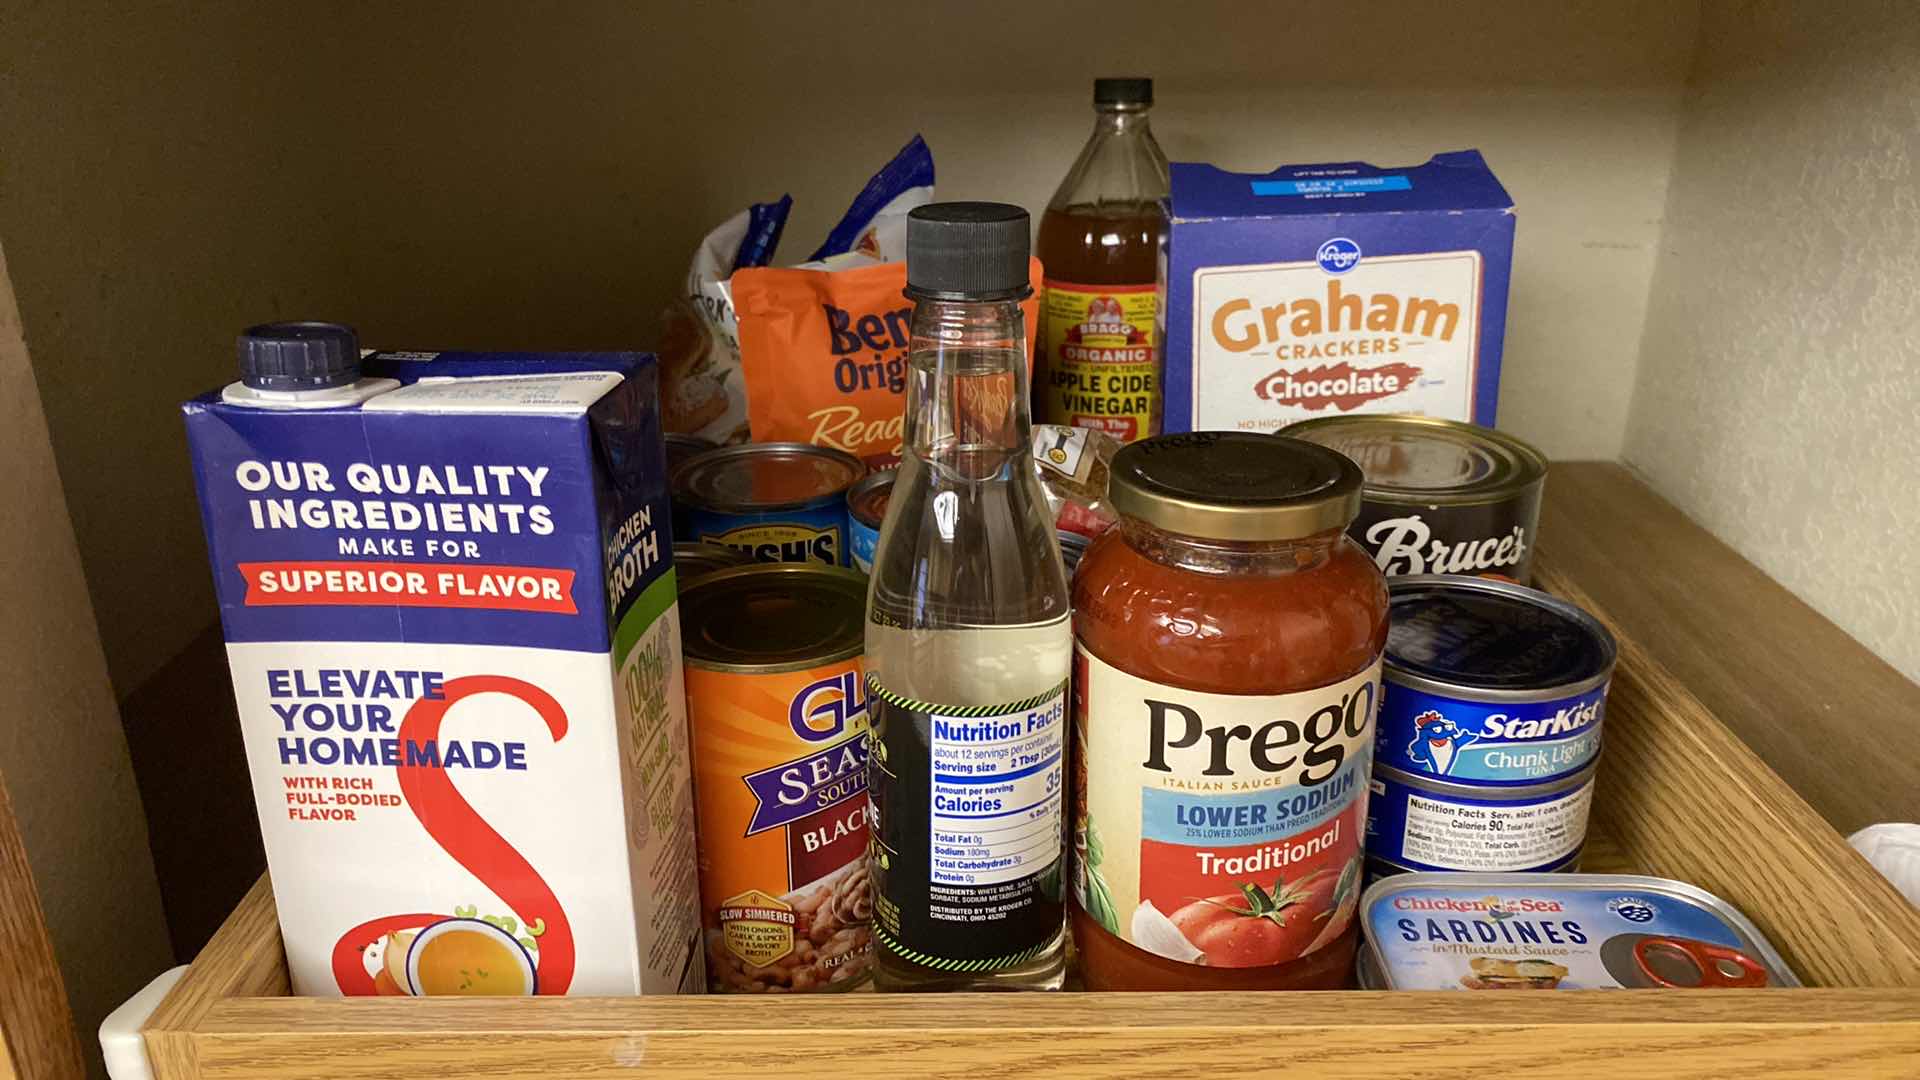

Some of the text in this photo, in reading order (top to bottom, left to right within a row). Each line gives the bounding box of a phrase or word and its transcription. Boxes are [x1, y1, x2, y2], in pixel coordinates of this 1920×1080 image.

[1320, 245, 1358, 268] Kroger
[1211, 279, 1460, 353] Graham
[1080, 323, 1133, 335] BRAGG
[1065, 348, 1147, 362] ORGANIC
[1276, 337, 1400, 361] CRACKERS
[1265, 371, 1399, 401] Chocolate
[1062, 394, 1148, 415] VINEGAR
[235, 460, 551, 498] OUR QUALITY
[249, 499, 555, 535] INGREDIENTS
[338, 537, 481, 558] MAKE FOR
[608, 504, 652, 571] CHICKEN
[1366, 514, 1527, 577] Bruce's
[706, 534, 836, 566] USH'S
[609, 530, 659, 616] BROTH
[258, 568, 563, 601] SUPERIOR FLAVOR
[266, 669, 446, 702] ELEVATE
[271, 704, 396, 734] YOUR
[934, 703, 1062, 742] Nutrition Facts
[1479, 700, 1601, 739] StarKist
[1142, 681, 1374, 787] Prego
[277, 736, 528, 771] HOMEMADE
[934, 748, 959, 759] about
[961, 748, 972, 759] 12
[974, 748, 1009, 761] servings
[1010, 758, 1017, 768] 2
[1019, 752, 1040, 766] Tbsp
[1484, 750, 1547, 769] Chunk
[1552, 740, 1586, 766] Light
[934, 760, 997, 774] Serving size
[1526, 763, 1556, 778] TUNA
[283, 776, 373, 791] WITH RICH
[934, 767, 1060, 812] Calories 35
[934, 783, 1014, 797] Amount per serving
[1163, 776, 1282, 791] ITALIAN SAUCE
[286, 792, 402, 808] FULL-BODIED
[1177, 767, 1355, 828] LOWER SODIUM
[288, 807, 357, 822] FLAVOR
[1410, 798, 1455, 815] Nutrition
[1457, 807, 1486, 819] Facts
[1490, 811, 1513, 820] Serv.
[1186, 827, 1202, 837] 25%
[1203, 828, 1231, 839] LOWER
[1233, 826, 1264, 838] SODIUM
[1265, 821, 1286, 833] THAN
[1451, 818, 1487, 832] Calories
[934, 833, 956, 843] Total
[958, 834, 972, 844] Fat
[1196, 818, 1341, 875] Traditional
[934, 846, 965, 857] Sodium
[934, 859, 957, 868] Total
[957, 857, 1012, 870] Carbohydrate
[934, 871, 964, 882] Protein
[930, 886, 977, 896] INGREDIENTS:
[977, 886, 997, 895] WHITE
[930, 893, 961, 903] SORBATE,
[962, 895, 988, 904] SODIUM
[930, 905, 973, 915] DISTRIBUTED
[974, 907, 983, 915] BY
[985, 906, 997, 914] THE
[998, 902, 1023, 912] KROGER
[1393, 896, 1487, 913] Chicken
[1520, 898, 1563, 913] Sea
[720, 908, 796, 925] SLOW SIMMERED
[930, 912, 969, 922] CINCINNATI,
[970, 914, 986, 922] OHIO
[1397, 917, 1588, 945] SARDINES
[1447, 943, 1521, 956] Mustard
[1523, 944, 1570, 957] Sauce
